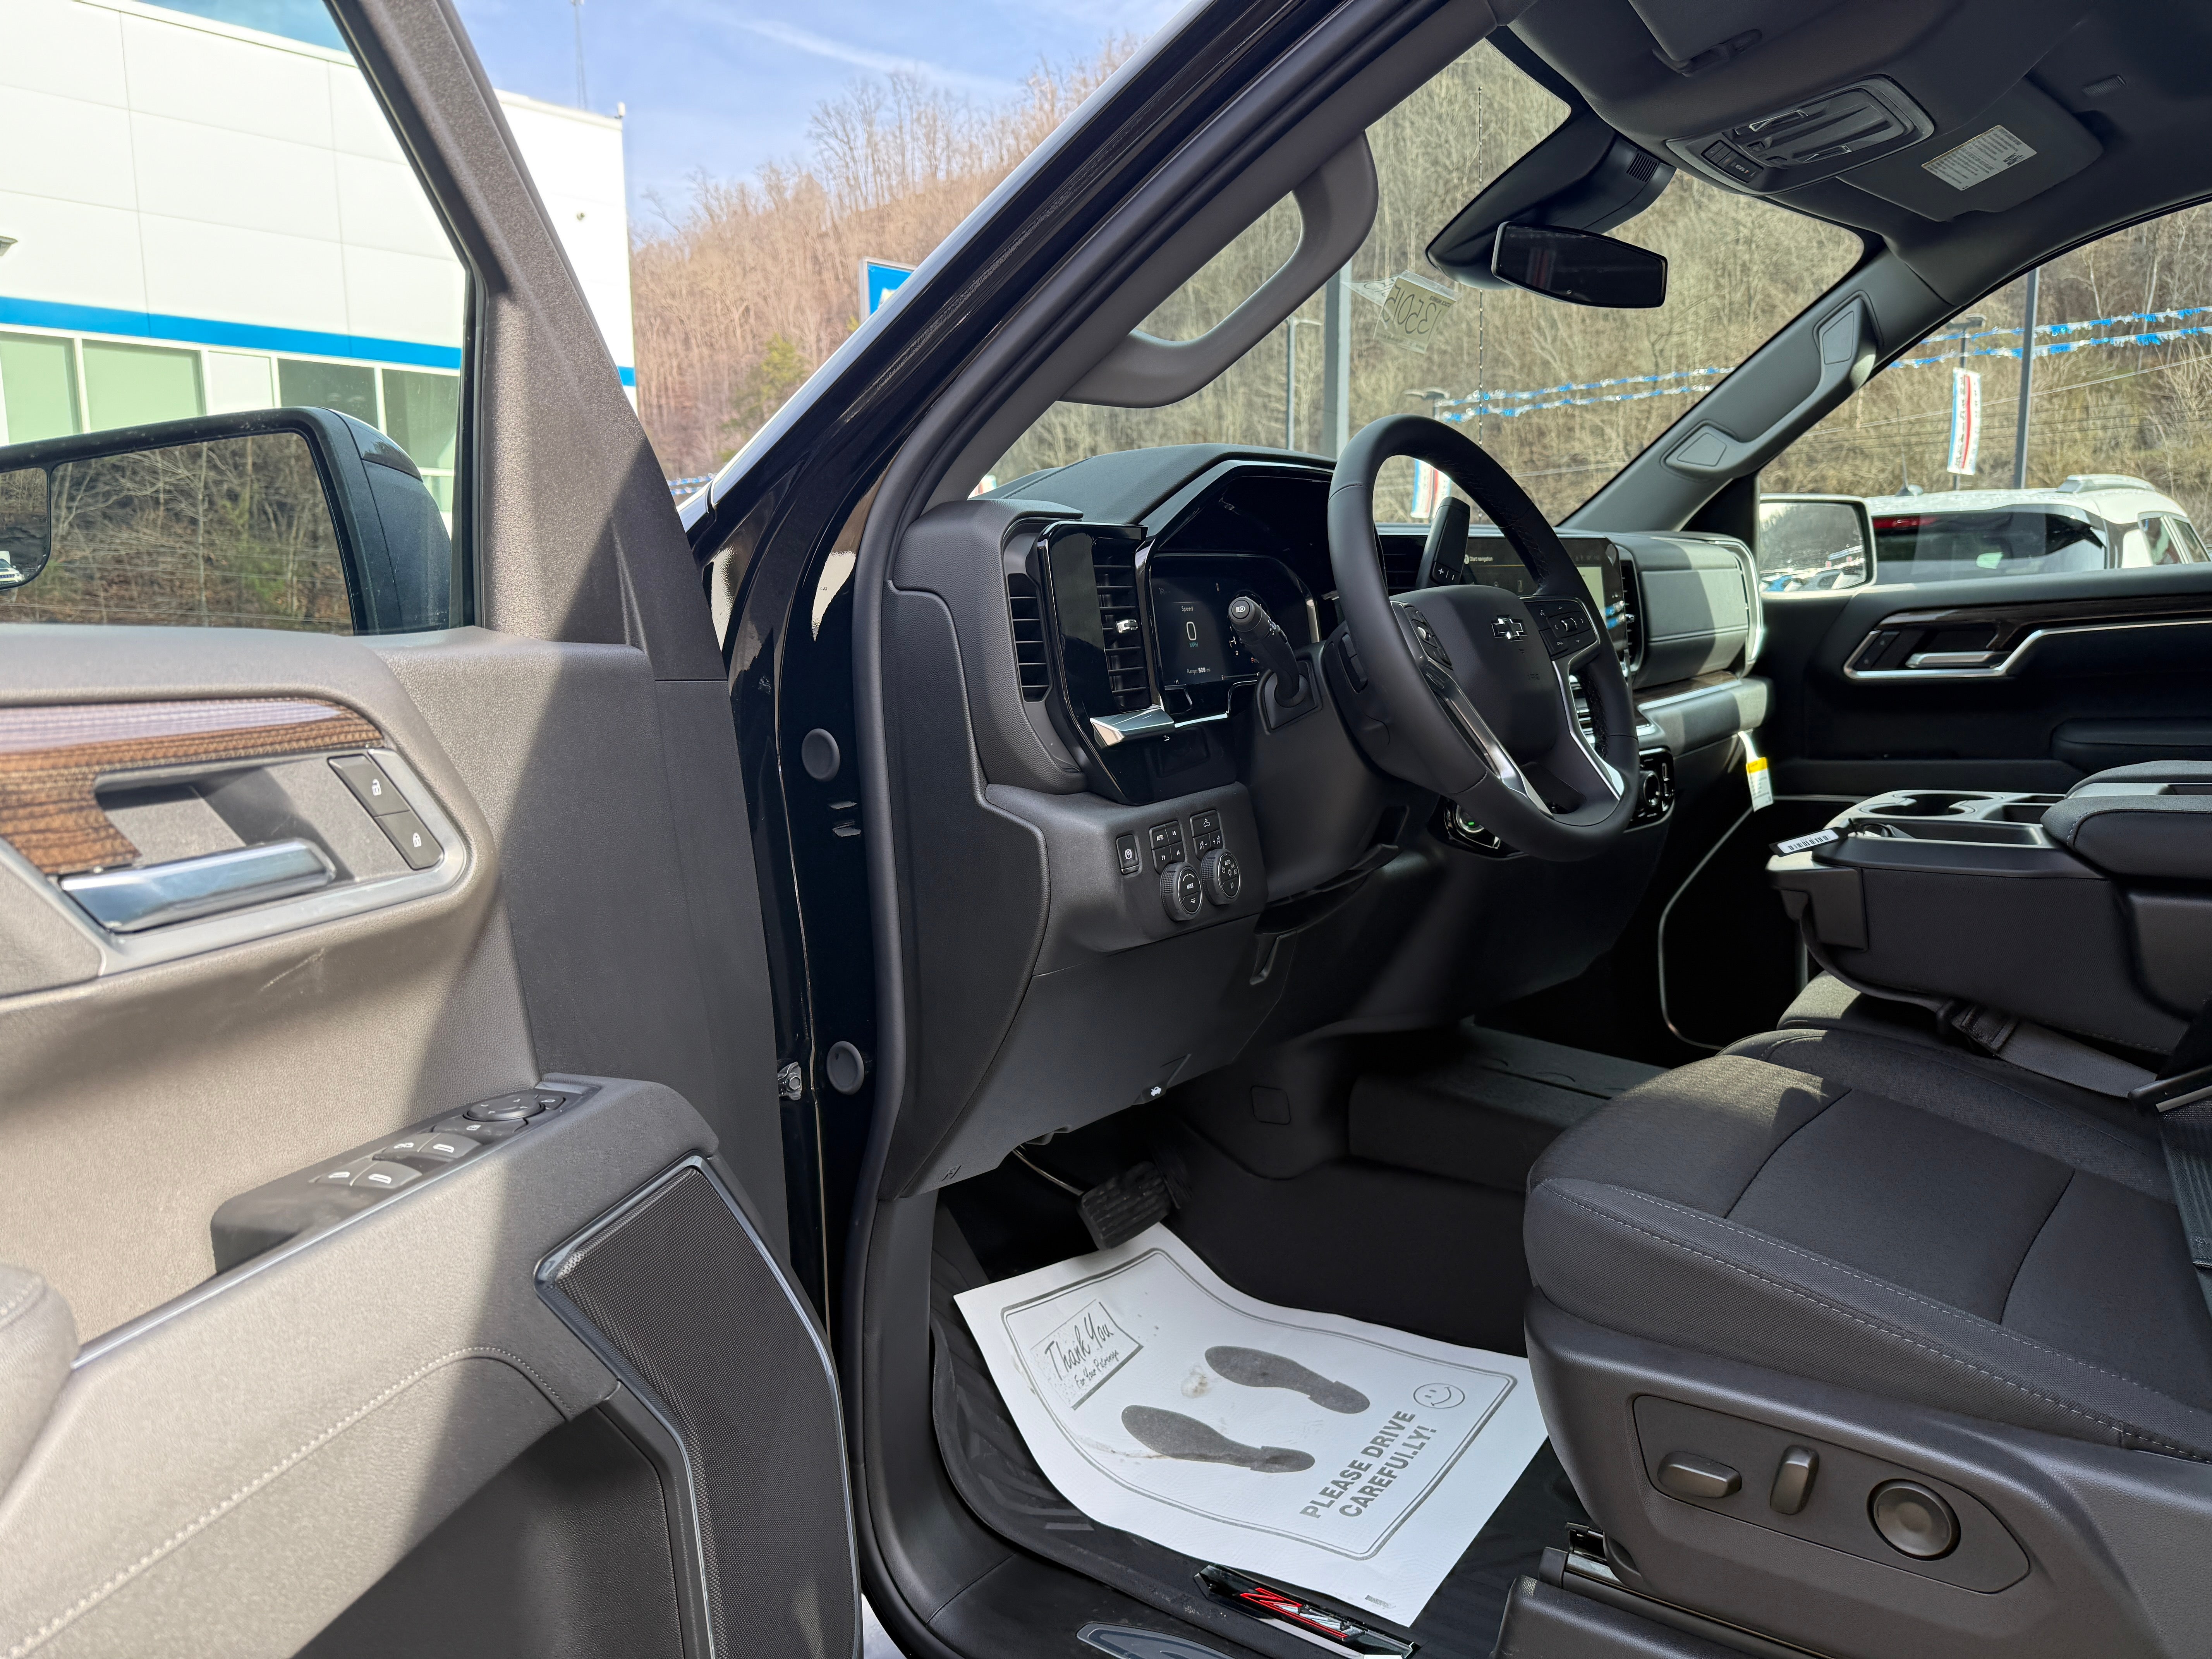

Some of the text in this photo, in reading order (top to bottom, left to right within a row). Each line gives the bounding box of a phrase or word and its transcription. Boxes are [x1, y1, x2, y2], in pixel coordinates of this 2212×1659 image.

[1186, 621, 1197, 641] 0
[1044, 1312, 1114, 1381] Thank You
[1299, 1410, 1416, 1518] PLEASE DRIVE
[1339, 1425, 1437, 1517] CAREFULLY!
